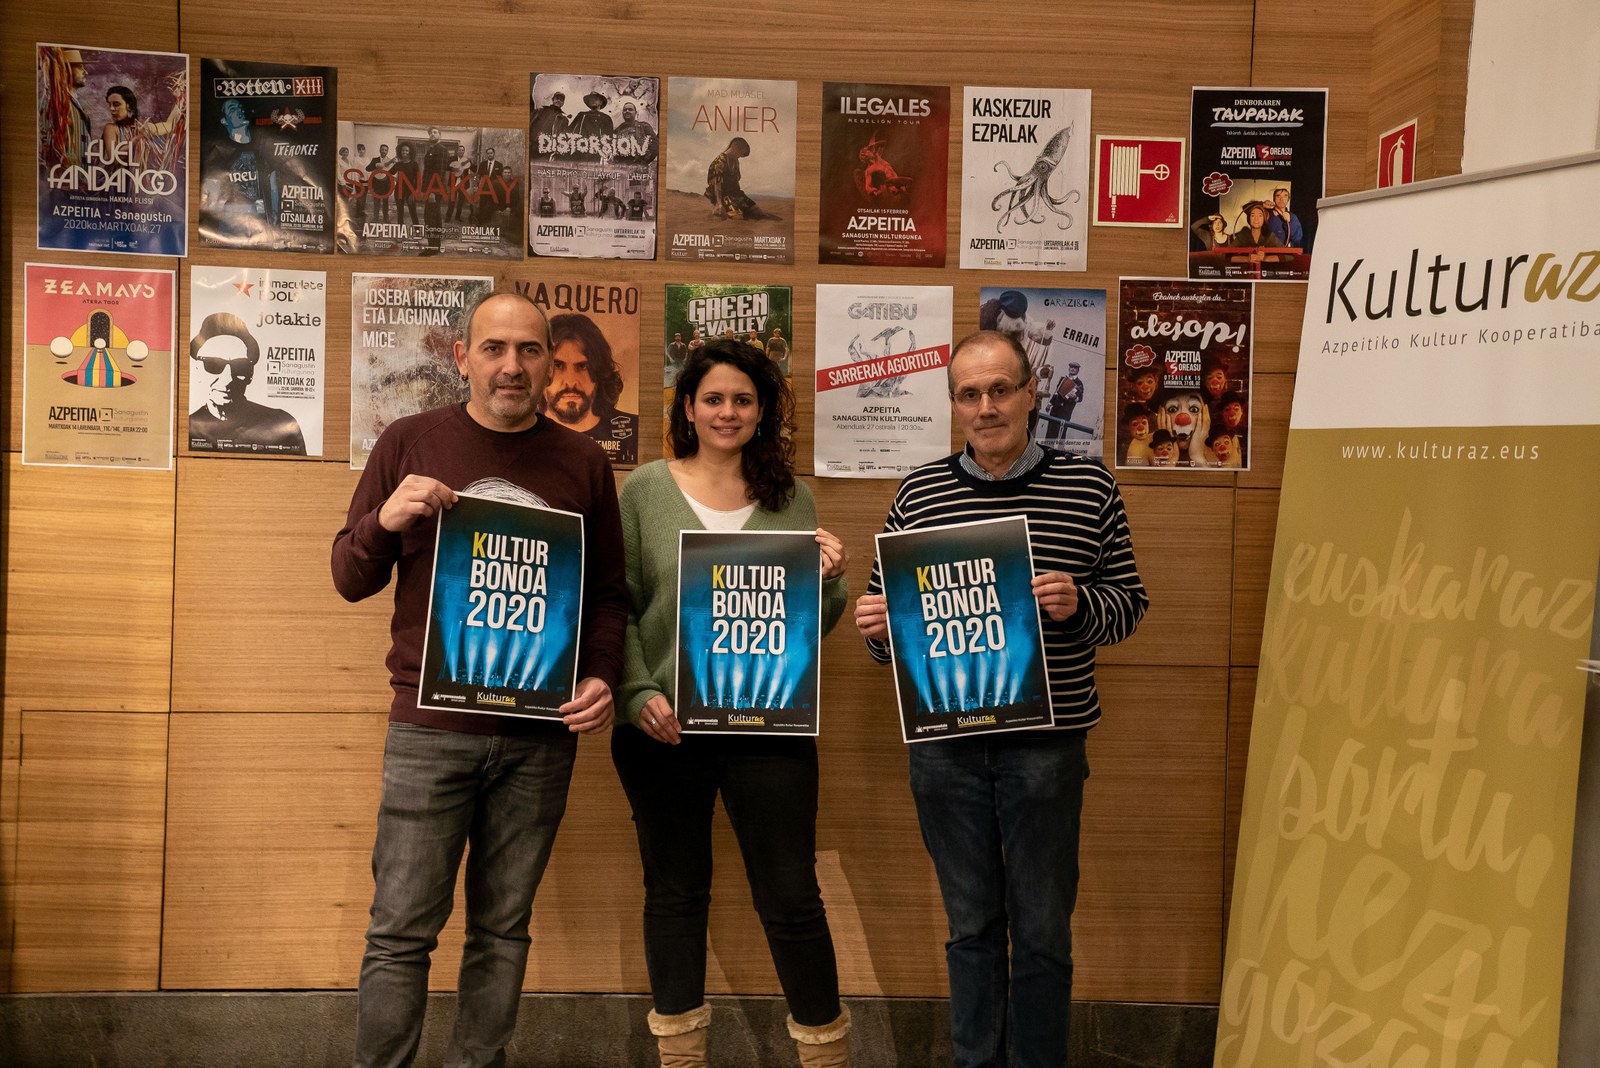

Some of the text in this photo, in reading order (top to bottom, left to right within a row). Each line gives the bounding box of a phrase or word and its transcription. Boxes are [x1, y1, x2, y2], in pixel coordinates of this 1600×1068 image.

[296, 79, 322, 94] XIII
[707, 89, 764, 99] MAD MUASEL
[840, 97, 931, 117] ILEGALES
[972, 98, 1051, 118] KASKEZUR
[1212, 108, 1304, 121] TAUPADAK
[692, 104, 780, 133] ANIER
[972, 123, 1038, 143] EZPALAK
[85, 140, 140, 166] FUEL
[274, 142, 318, 156] TXEROKEE
[1221, 147, 1256, 159] AZPEITIA
[47, 164, 177, 196] FANDANGO
[342, 168, 520, 204] SONAKAY
[109, 196, 132, 204] HAKIMA
[282, 185, 324, 200] AZPEITIA
[53, 206, 101, 218] AZPEITIA
[114, 209, 172, 223] Sanagustin
[281, 213, 323, 224] OTSAILAK 8
[847, 216, 916, 231] AZPEITIA
[362, 223, 500, 238] AZPEITIA Sanagustin OTSAILAK 1
[537, 225, 574, 237] AZPEITIA
[673, 234, 710, 246] AZPEITIA
[970, 239, 1005, 250] AZPEITIA
[44, 279, 155, 299] ZEA MAYS
[1326, 248, 1600, 324] Kulturaz
[363, 289, 464, 307] JOSEBA IRAZOKI
[363, 308, 450, 326] ETA LAGUNAK
[689, 293, 767, 324] GREEN
[848, 303, 918, 320] GATIBU
[256, 312, 321, 328] jotakie
[706, 316, 767, 338] VALLEY
[363, 331, 396, 348] MICE
[1131, 314, 1246, 353] alejop!
[1322, 321, 1600, 356] Azpeitiko Kultur Kooperatiba
[267, 347, 315, 361] AZPEITIA
[1164, 350, 1201, 363] AZPEITIA
[282, 360, 315, 369] Sanagustin
[828, 350, 942, 386] SARRERAK AGORTUTA
[267, 376, 315, 386] MARTXOAK 20
[48, 406, 149, 421] AZPEITIA Sanagustin
[1342, 441, 1540, 460] www.kulturaz.eus
[472, 532, 549, 566] KULTUR
[470, 559, 547, 595] BONOA
[712, 565, 786, 591] KULTUR
[916, 557, 997, 592] KULTUR
[1283, 506, 1592, 639] euskaraz
[467, 590, 546, 634] 2020
[712, 590, 786, 619] BONOA
[920, 585, 1001, 622] BONOA
[712, 619, 786, 655] 2020
[927, 614, 1006, 658] 2020
[1258, 599, 1574, 748] kultura
[477, 692, 516, 703] Kulturaz
[728, 714, 764, 723] Kulturaz
[957, 715, 996, 725] Kulturaz
